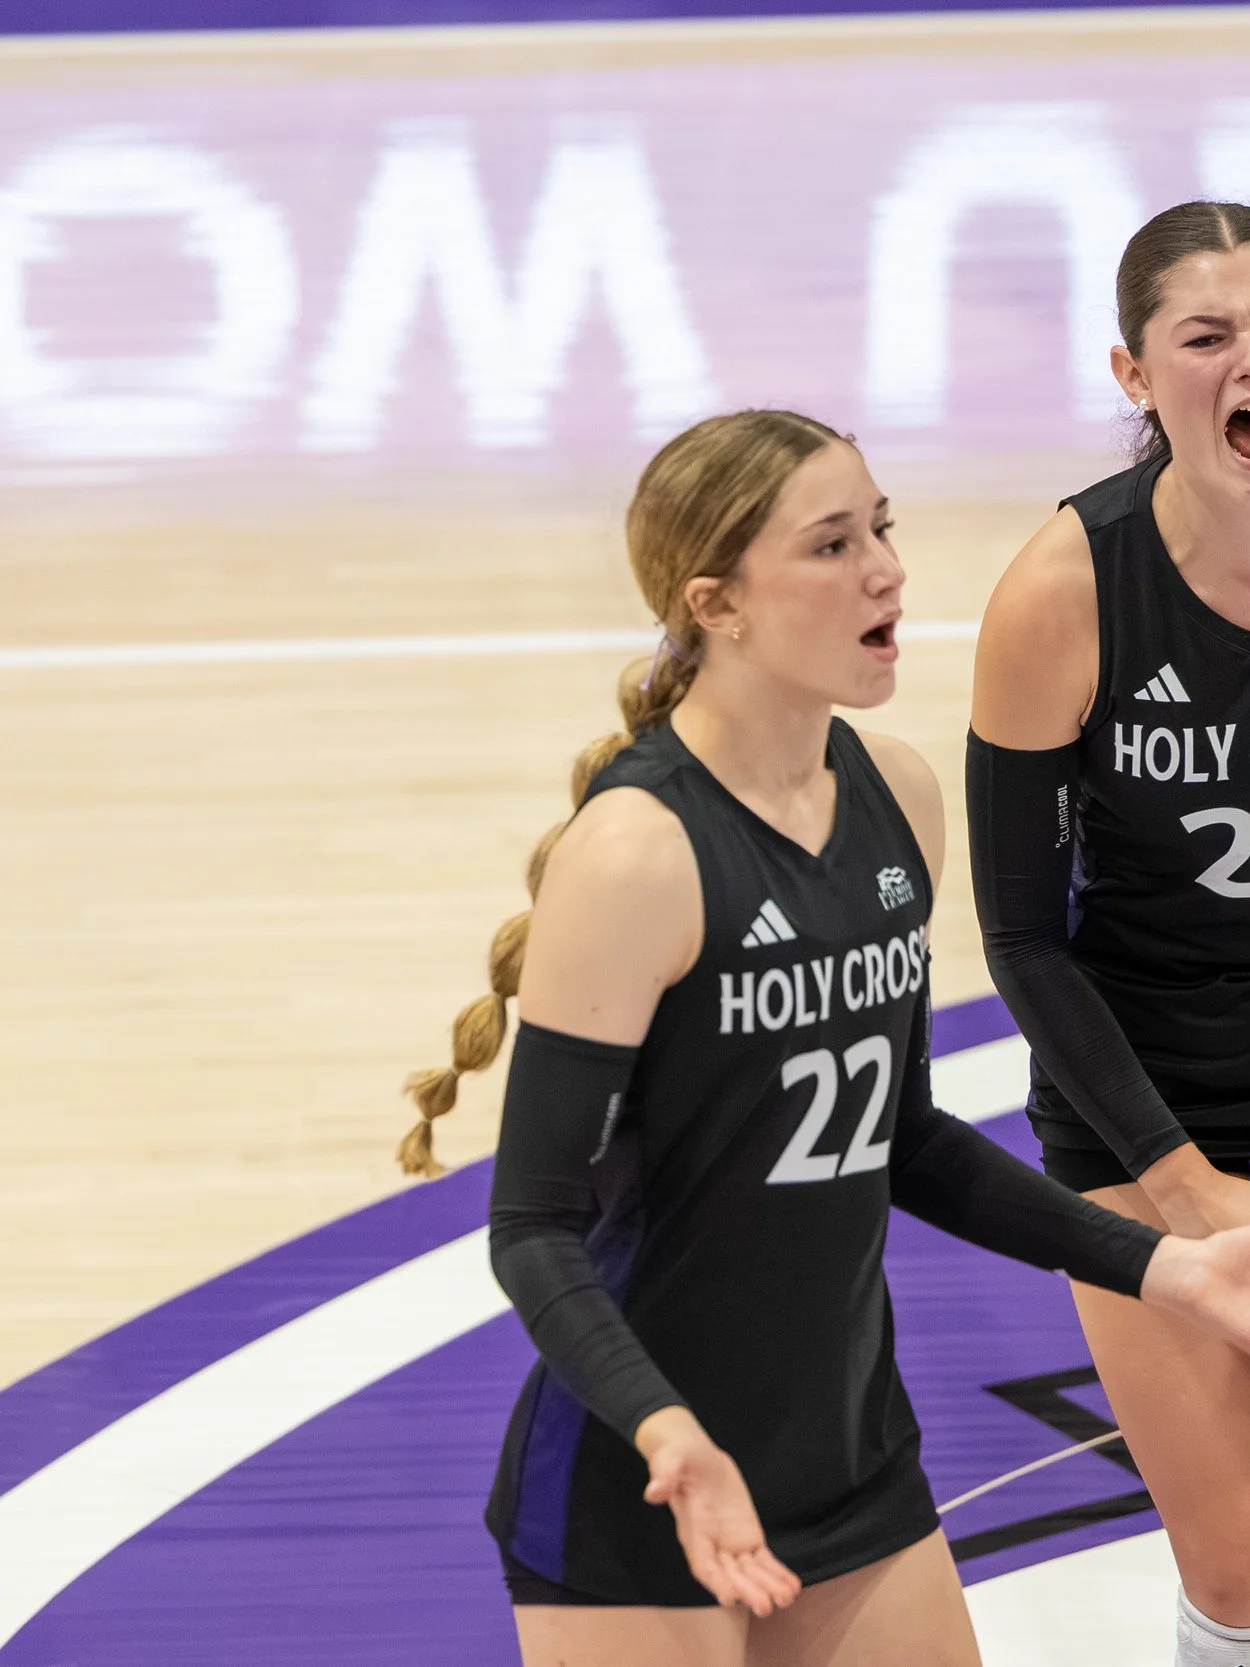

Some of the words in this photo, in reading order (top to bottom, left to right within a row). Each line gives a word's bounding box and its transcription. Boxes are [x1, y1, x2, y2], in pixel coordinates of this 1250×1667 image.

[1114, 721, 1237, 783] HOLY
[719, 955, 835, 1035] HOLY
[765, 1034, 892, 1185] 22
